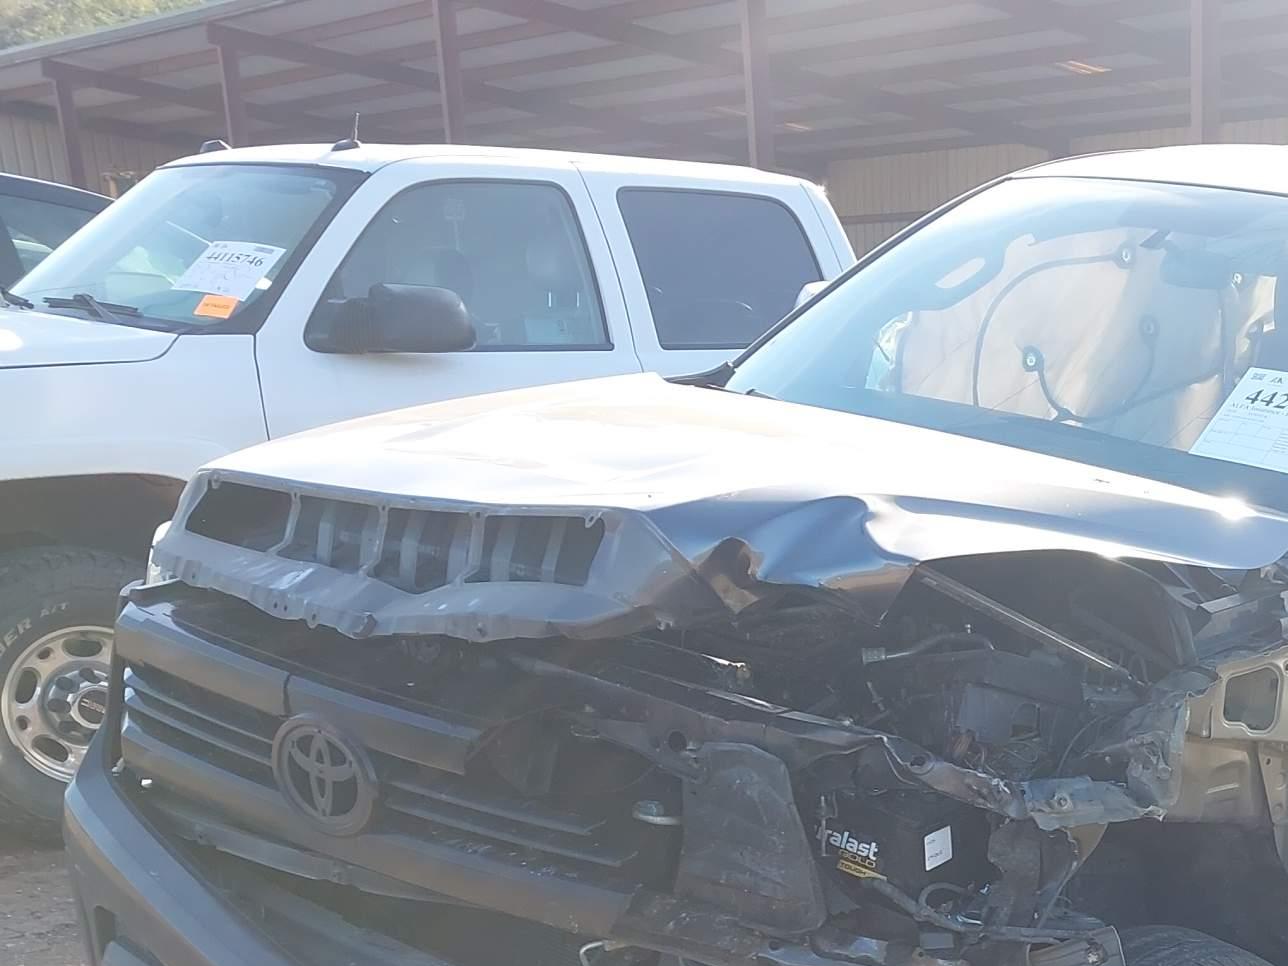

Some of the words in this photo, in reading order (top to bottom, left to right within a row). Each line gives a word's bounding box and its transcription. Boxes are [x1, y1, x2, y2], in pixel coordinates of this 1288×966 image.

[206, 251, 264, 267] 44115746
[840, 849, 876, 868] GOLD
[839, 861, 867, 876] TOUGH
